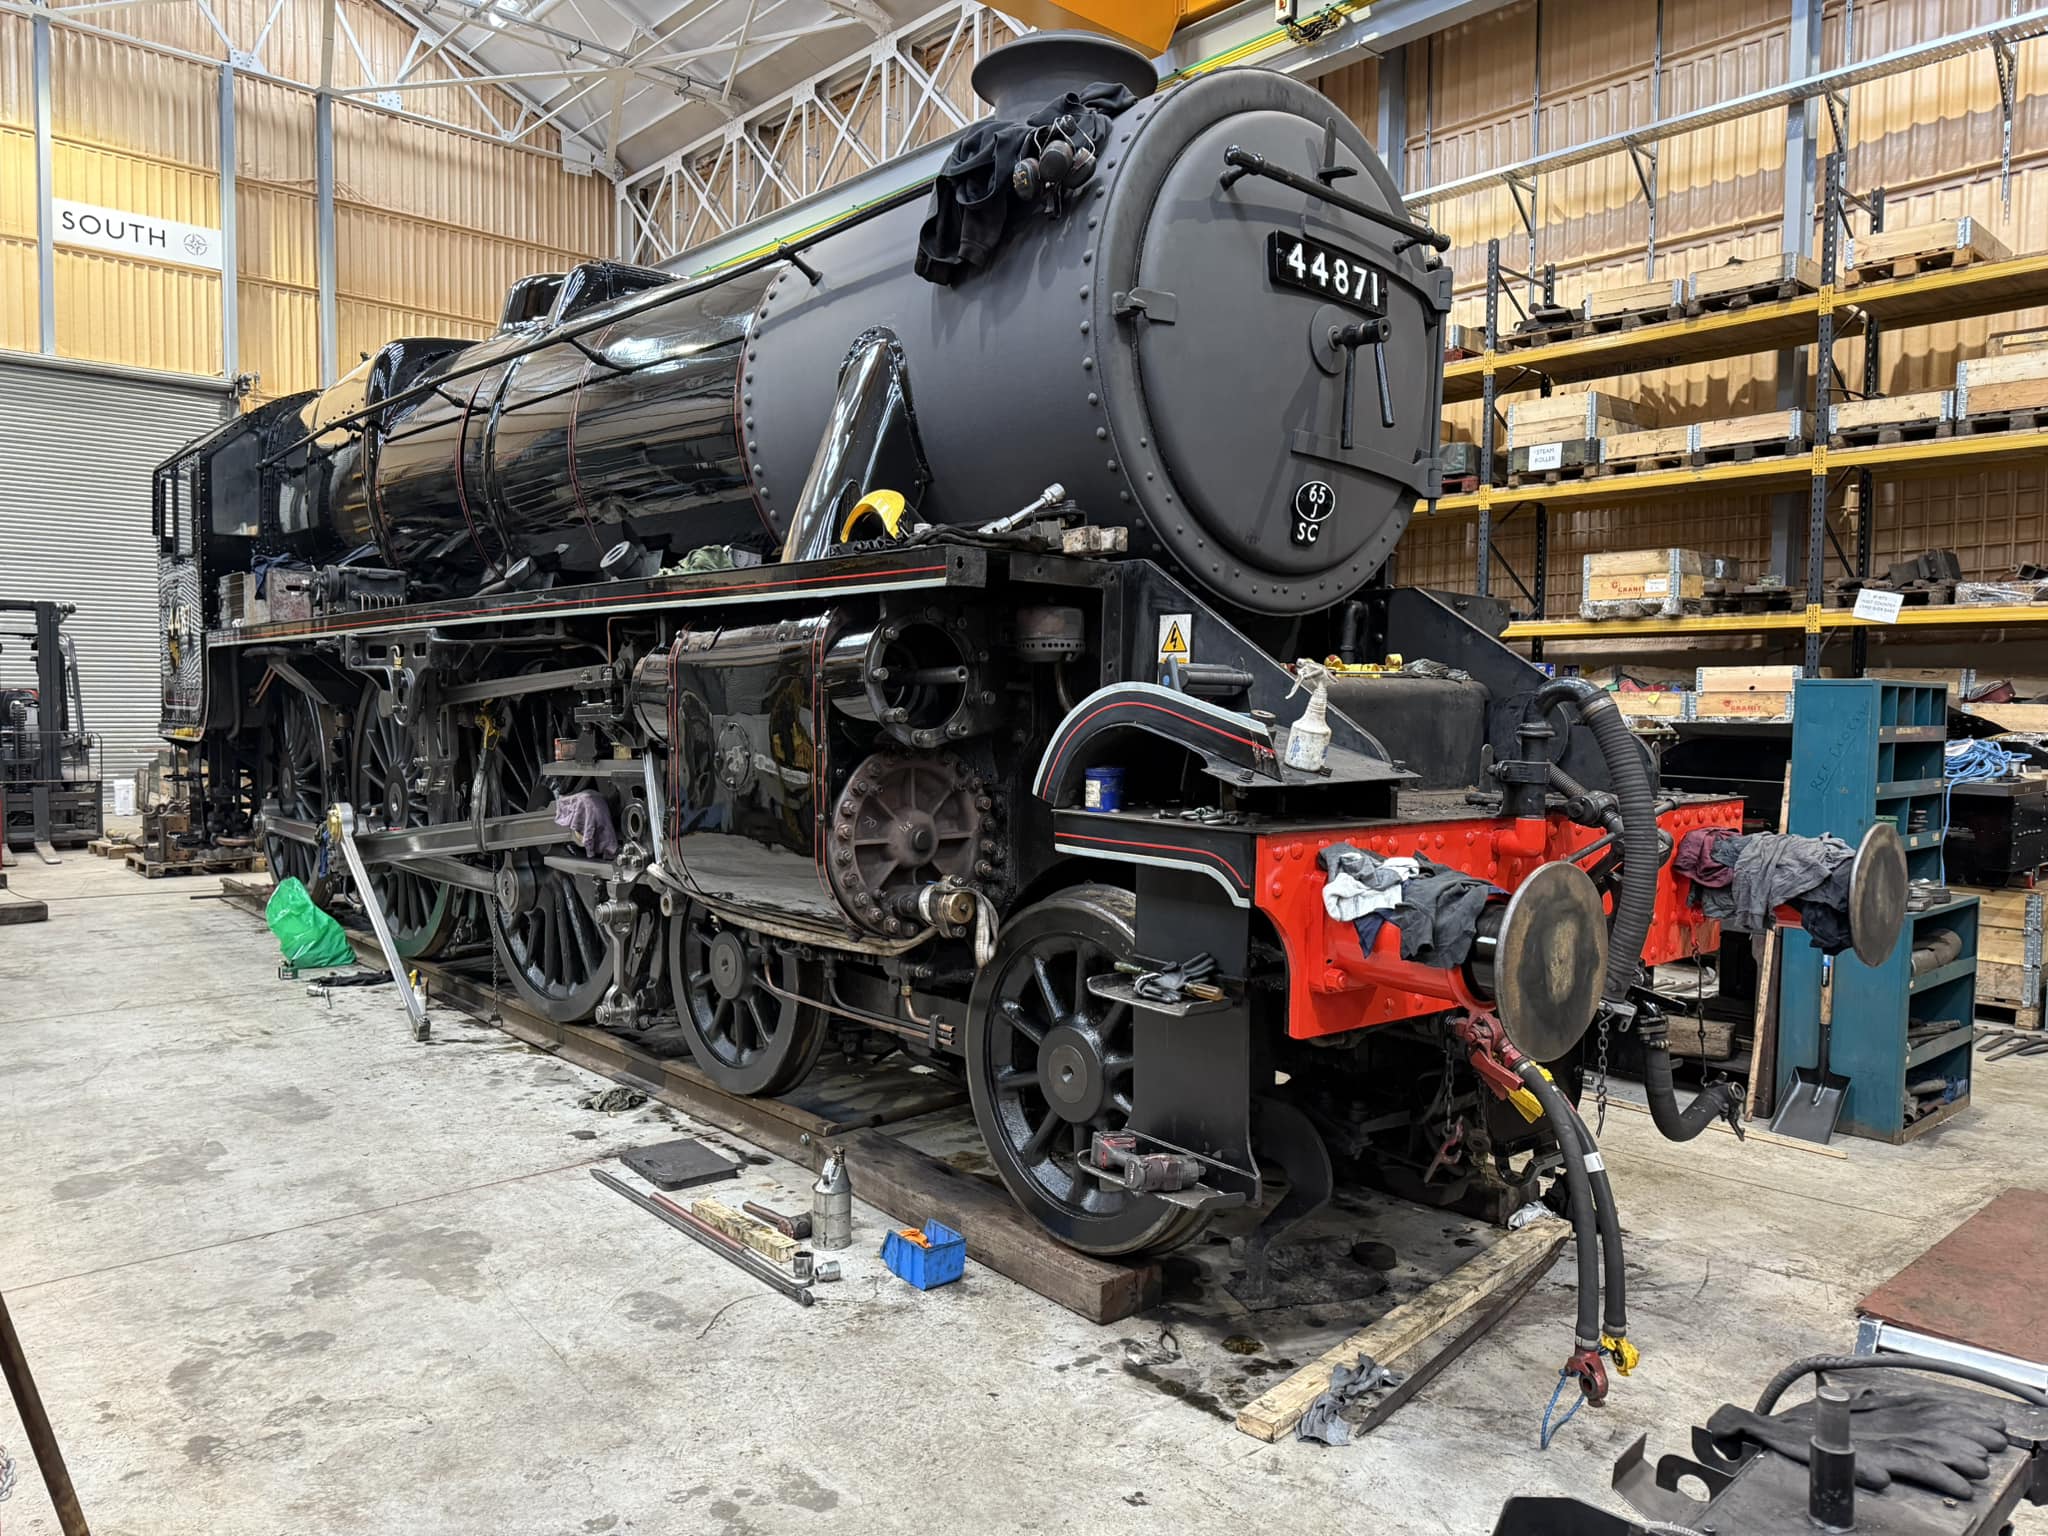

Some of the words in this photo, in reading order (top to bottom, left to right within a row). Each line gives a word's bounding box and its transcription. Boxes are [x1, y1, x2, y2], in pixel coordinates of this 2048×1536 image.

[62, 211, 166, 248] SOUTH
[1287, 242, 1379, 307] 44871
[1309, 484, 1327, 505] 65
[1297, 522, 1319, 542] SC
